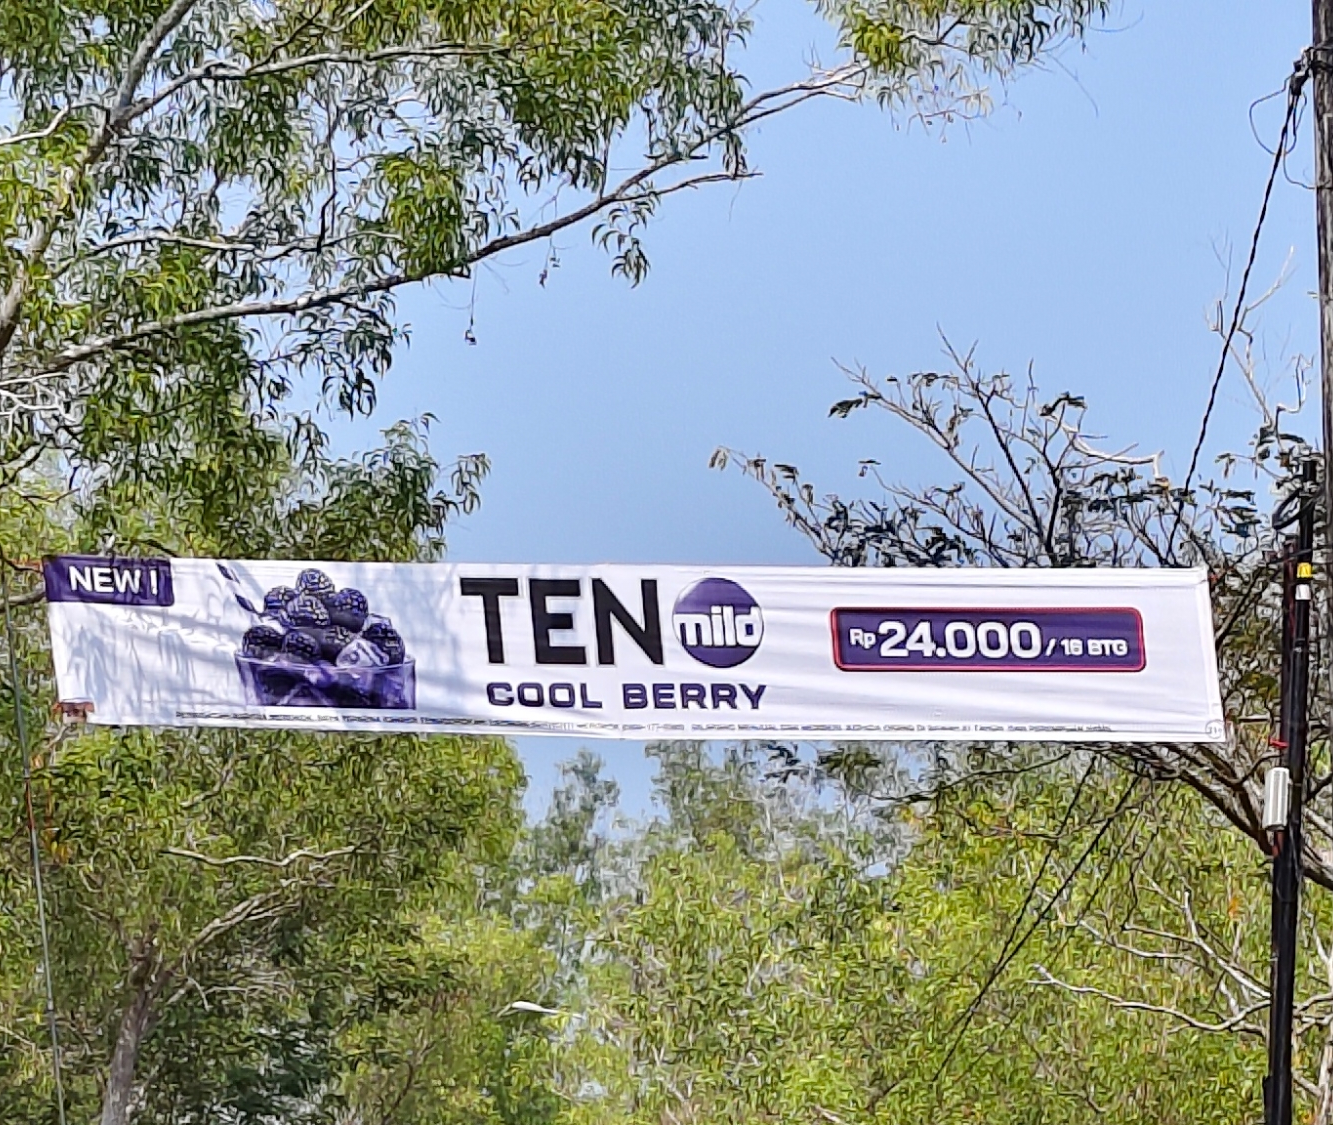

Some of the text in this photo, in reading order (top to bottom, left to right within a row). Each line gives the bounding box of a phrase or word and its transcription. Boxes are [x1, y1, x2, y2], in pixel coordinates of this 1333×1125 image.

[68, 565, 142, 595] NEW
[460, 577, 764, 666] TEN mild
[878, 621, 1042, 659] 24.000
[1087, 639, 1129, 657] BTG
[486, 682, 766, 710] COOL BERRY
